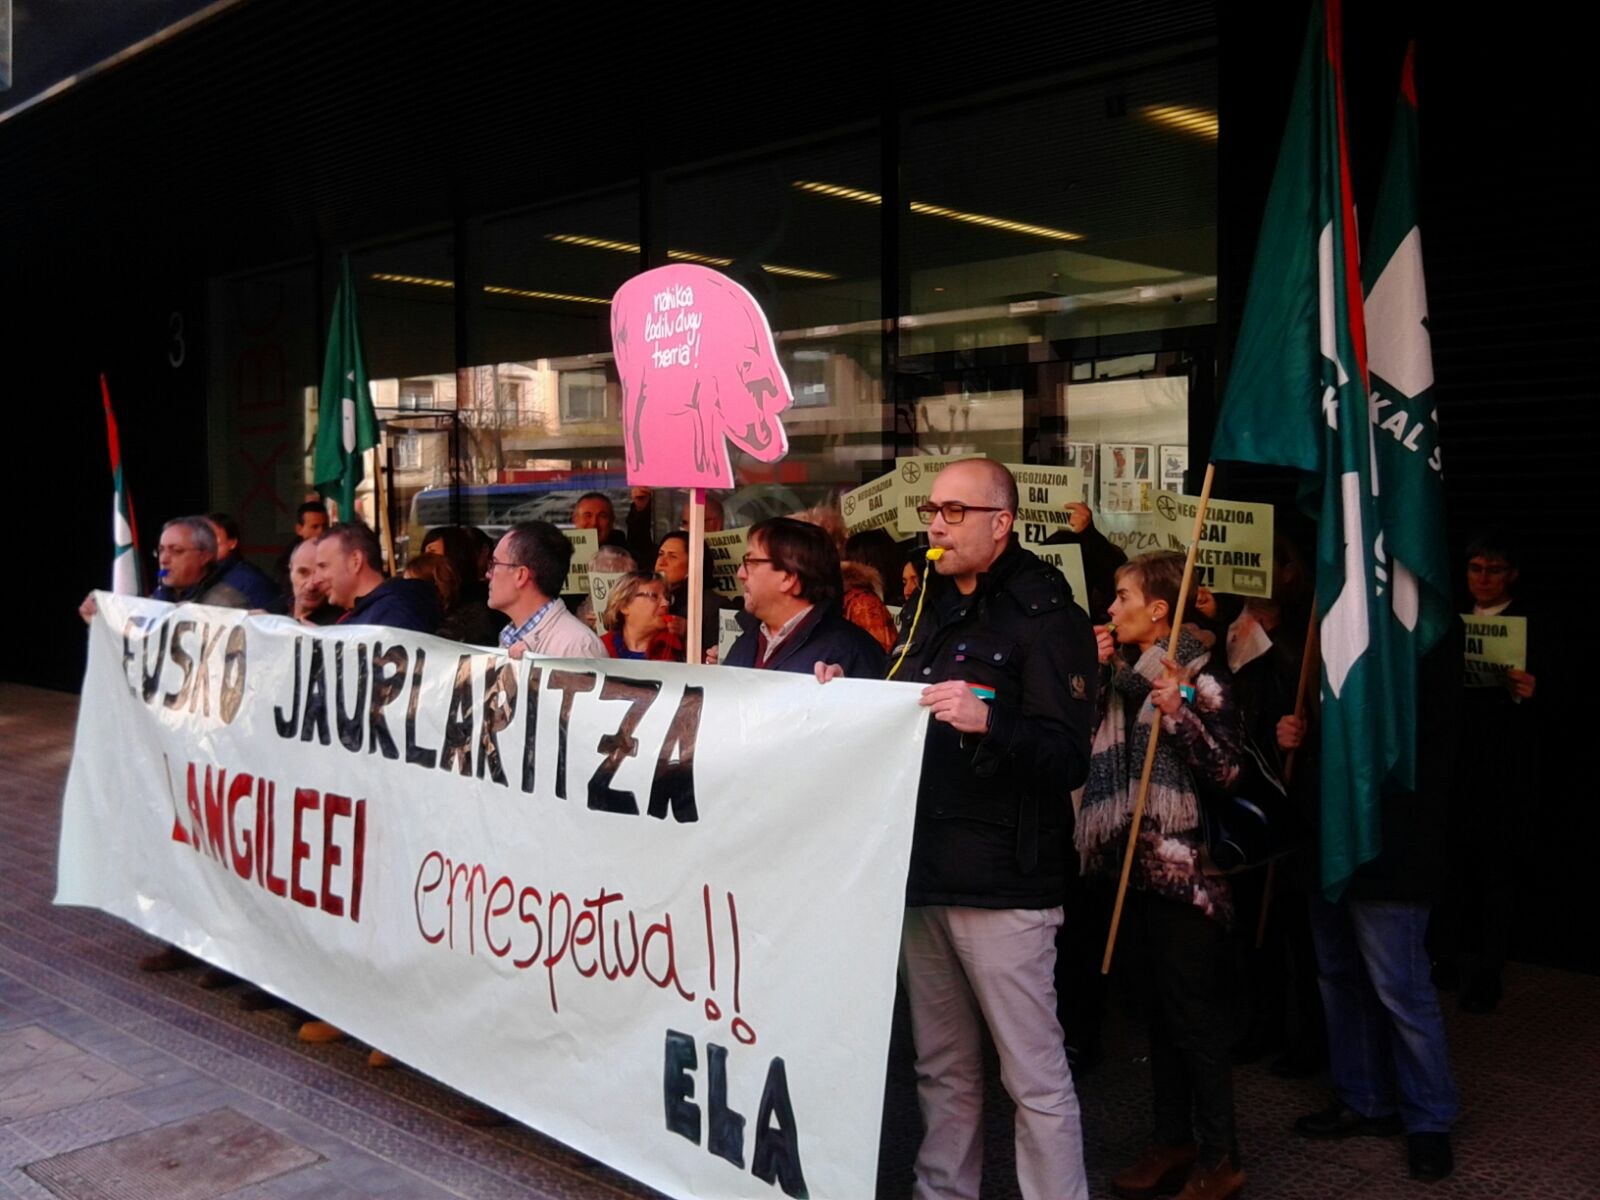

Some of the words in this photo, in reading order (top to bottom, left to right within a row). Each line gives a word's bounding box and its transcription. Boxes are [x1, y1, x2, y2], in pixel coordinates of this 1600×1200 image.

[167, 311, 186, 369] 3
[1368, 390, 1425, 452] KAL
[868, 494, 884, 512] BAI
[1029, 486, 1049, 504] BAI
[1177, 503, 1255, 525] NEGZIAZIOA
[1200, 523, 1227, 544] BAI
[1195, 567, 1215, 588] Z!
[1467, 623, 1508, 638] IAZIOA
[1467, 638, 1484, 655] AI
[122, 614, 248, 725] EUSKO
[272, 635, 704, 823] JAURLARITZA
[163, 752, 367, 923] LANGILEEI
[663, 1028, 810, 1200] ELA
